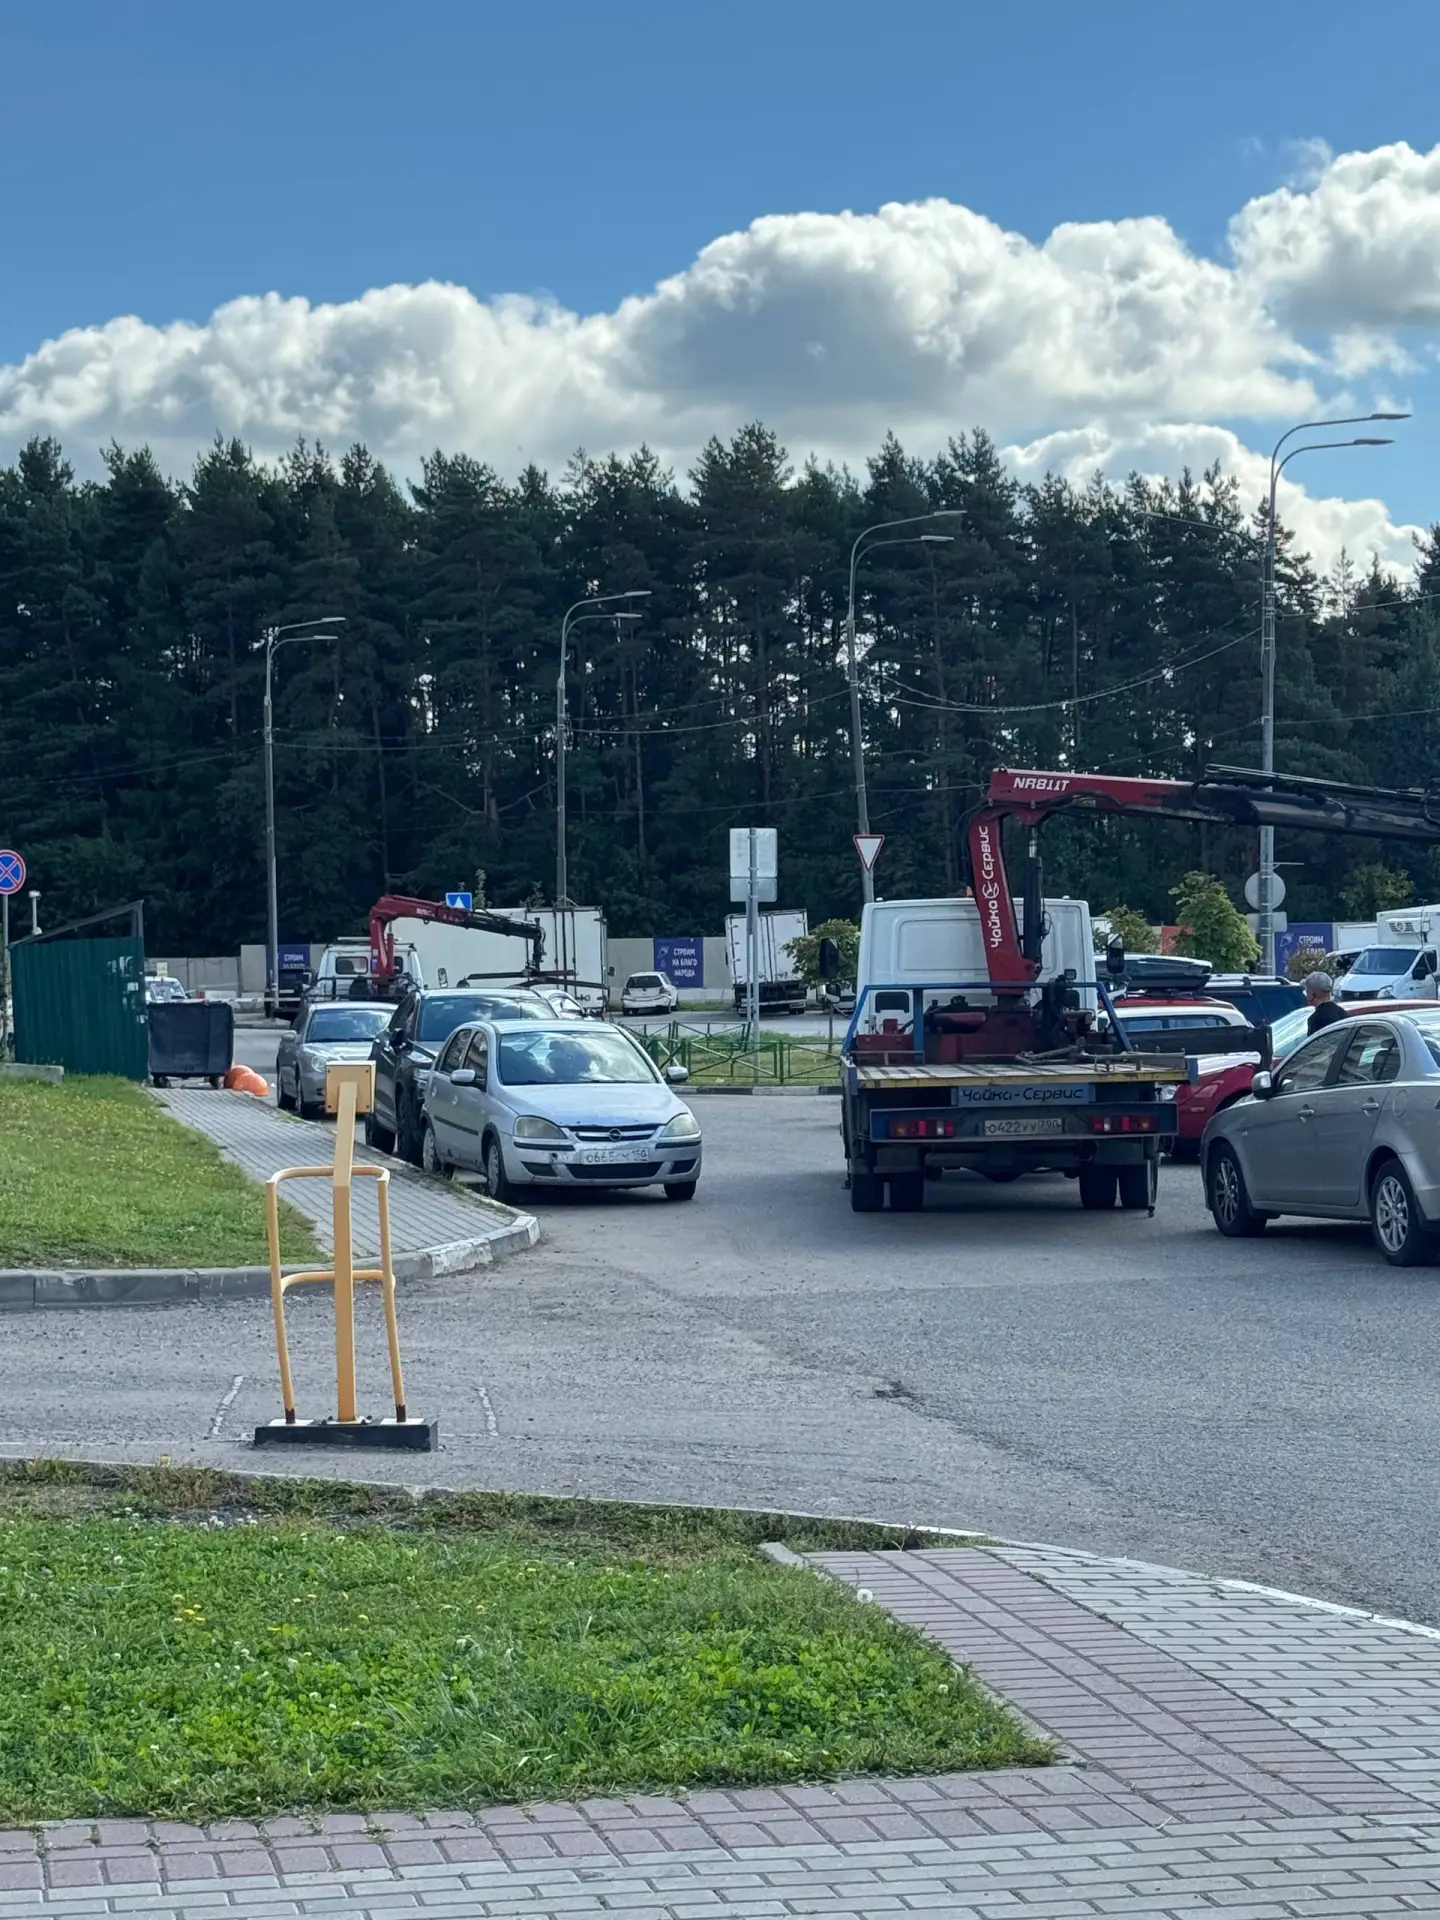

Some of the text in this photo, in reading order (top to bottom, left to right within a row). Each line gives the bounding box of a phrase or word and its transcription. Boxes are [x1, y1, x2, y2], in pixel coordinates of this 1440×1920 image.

[1013, 777, 1070, 792] NR811T
[1299, 935, 1324, 944] СТРОИМ
[673, 948, 696, 956] СТРОИМ
[672, 958, 698, 967] НА БЛАГО
[674, 969, 696, 978] НАРОДА
[962, 1087, 1084, 1102] Чайка-Сервис
